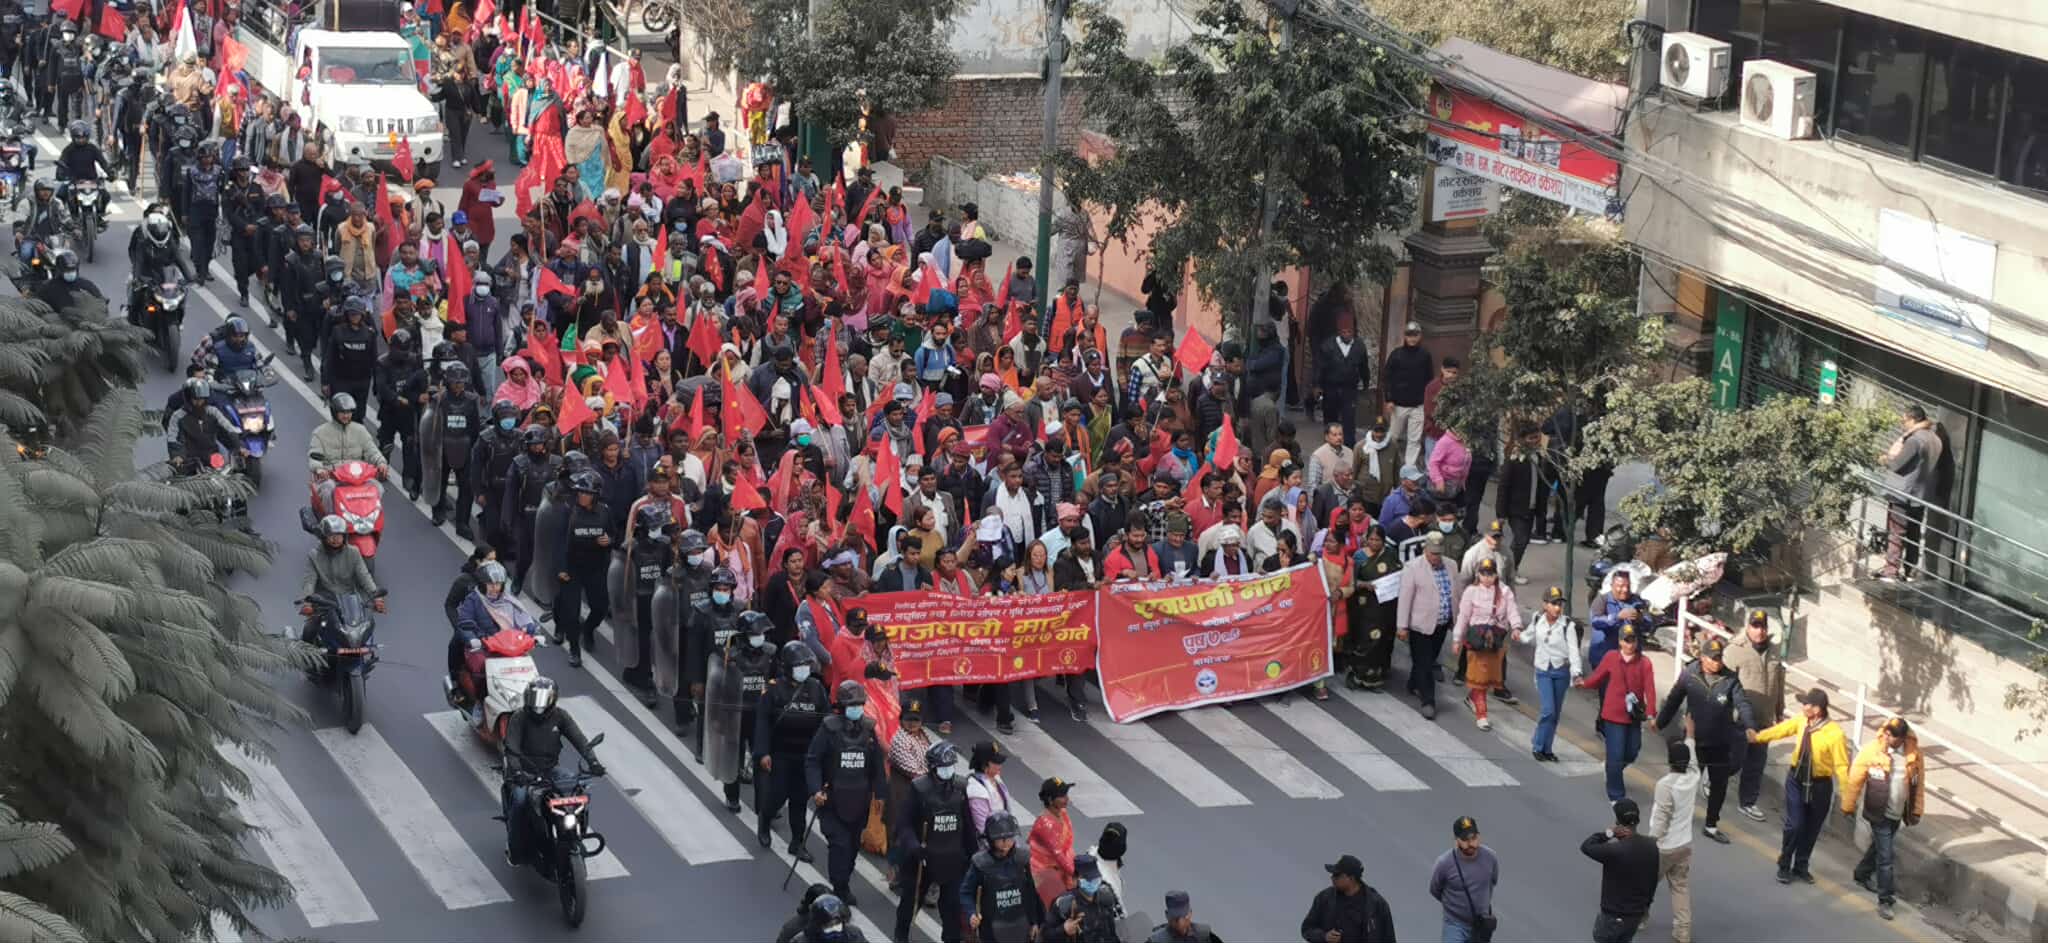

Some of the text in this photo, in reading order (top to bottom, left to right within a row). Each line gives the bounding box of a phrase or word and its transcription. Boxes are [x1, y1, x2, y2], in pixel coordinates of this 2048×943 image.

[886, 610, 1073, 641] राजधानी मार्च
[1055, 624, 1092, 641] गते
[743, 675, 765, 684] NEPAL
[743, 683, 766, 692] POLICE
[840, 752, 865, 760] NEPAL
[840, 760, 865, 769] POLICE
[934, 815, 957, 823] NEPAL
[933, 823, 957, 832] POLICE
[996, 888, 1021, 899] NEPAL
[997, 896, 1022, 908] POLICE
